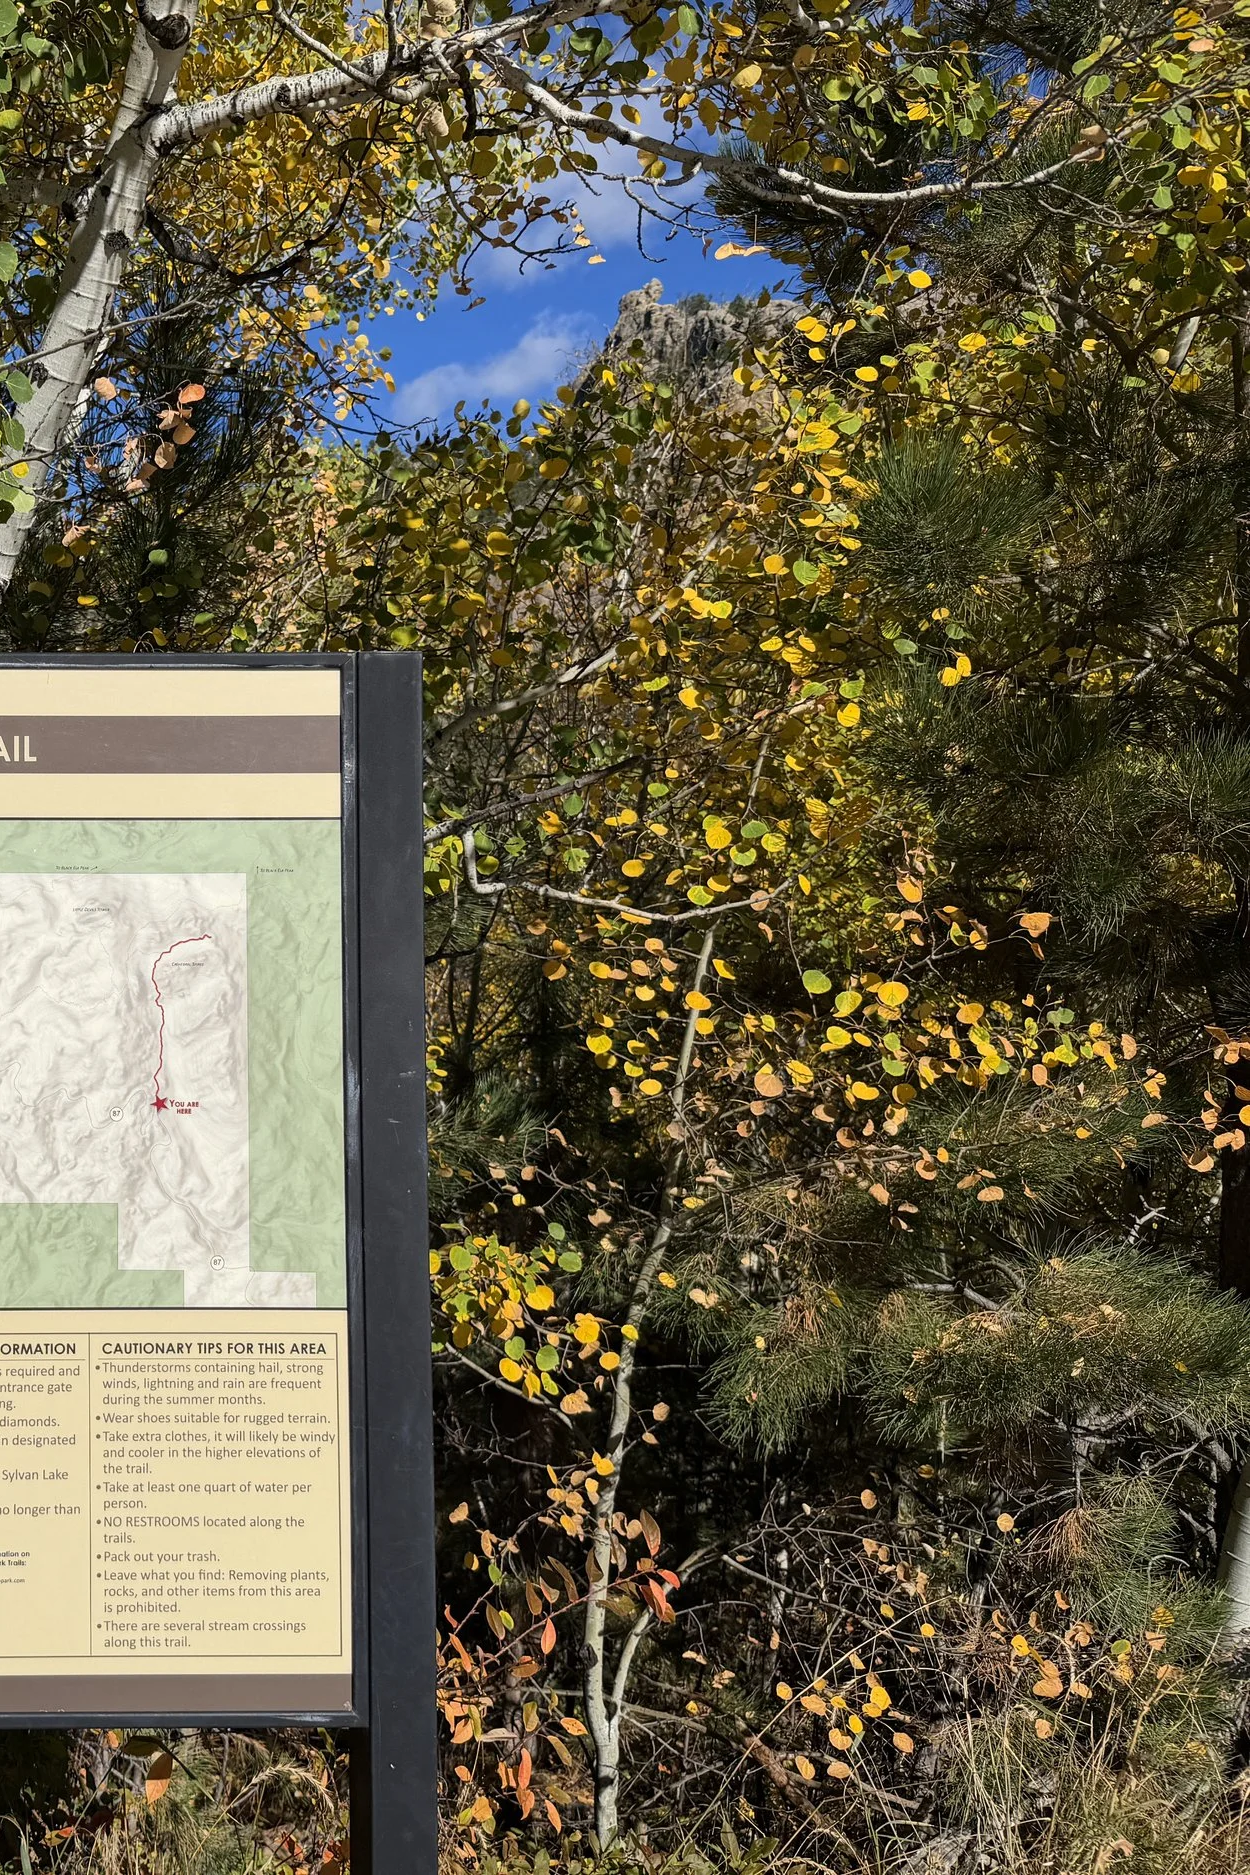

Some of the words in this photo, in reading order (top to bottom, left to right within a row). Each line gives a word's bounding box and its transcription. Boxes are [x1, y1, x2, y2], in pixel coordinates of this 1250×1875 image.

[169, 1099, 185, 1108] YOU
[213, 1258, 222, 1266] 87
[102, 1342, 193, 1355] CAUTIONARY
[197, 1342, 223, 1354] TIPS
[227, 1342, 254, 1354] FOR
[258, 1342, 285, 1355] THIS
[290, 1343, 327, 1355] AREA
[5, 1365, 55, 1379] required
[58, 1365, 80, 1376] and
[47, 1382, 72, 1395] gate
[0, 1415, 60, 1427] diamonds.
[102, 1412, 134, 1423] Wear
[137, 1412, 171, 1423] shoes
[174, 1412, 220, 1423] suitable
[223, 1411, 240, 1423] for
[244, 1412, 284, 1426] rugged
[288, 1412, 330, 1424] terrain.
[2, 1469, 39, 1483] Sylvan
[43, 1468, 69, 1480] Lake
[103, 1481, 129, 1493] Take
[132, 1483, 144, 1493] at
[147, 1481, 175, 1493] least
[178, 1484, 201, 1492] one
[204, 1483, 236, 1495] quart
[239, 1481, 252, 1493] of
[254, 1482, 289, 1493] water
[292, 1484, 312, 1495] per
[103, 1500, 147, 1511] person.
[104, 1516, 122, 1527] NO
[126, 1516, 200, 1527] RESTROOMS
[203, 1515, 246, 1527] located
[249, 1516, 282, 1530] along
[285, 1516, 305, 1527] the
[103, 1532, 135, 1544] trails.
[104, 1550, 131, 1562] Pack
[133, 1552, 154, 1562] out
[156, 1553, 184, 1564] your
[187, 1550, 220, 1562] trash.
[103, 1620, 138, 1632] There
[141, 1623, 160, 1631] are
[163, 1619, 205, 1631] several
[208, 1621, 249, 1631] stream
[253, 1620, 306, 1633] crossings
[104, 1636, 137, 1650] along
[140, 1636, 161, 1647] this
[164, 1636, 191, 1647] trail.
